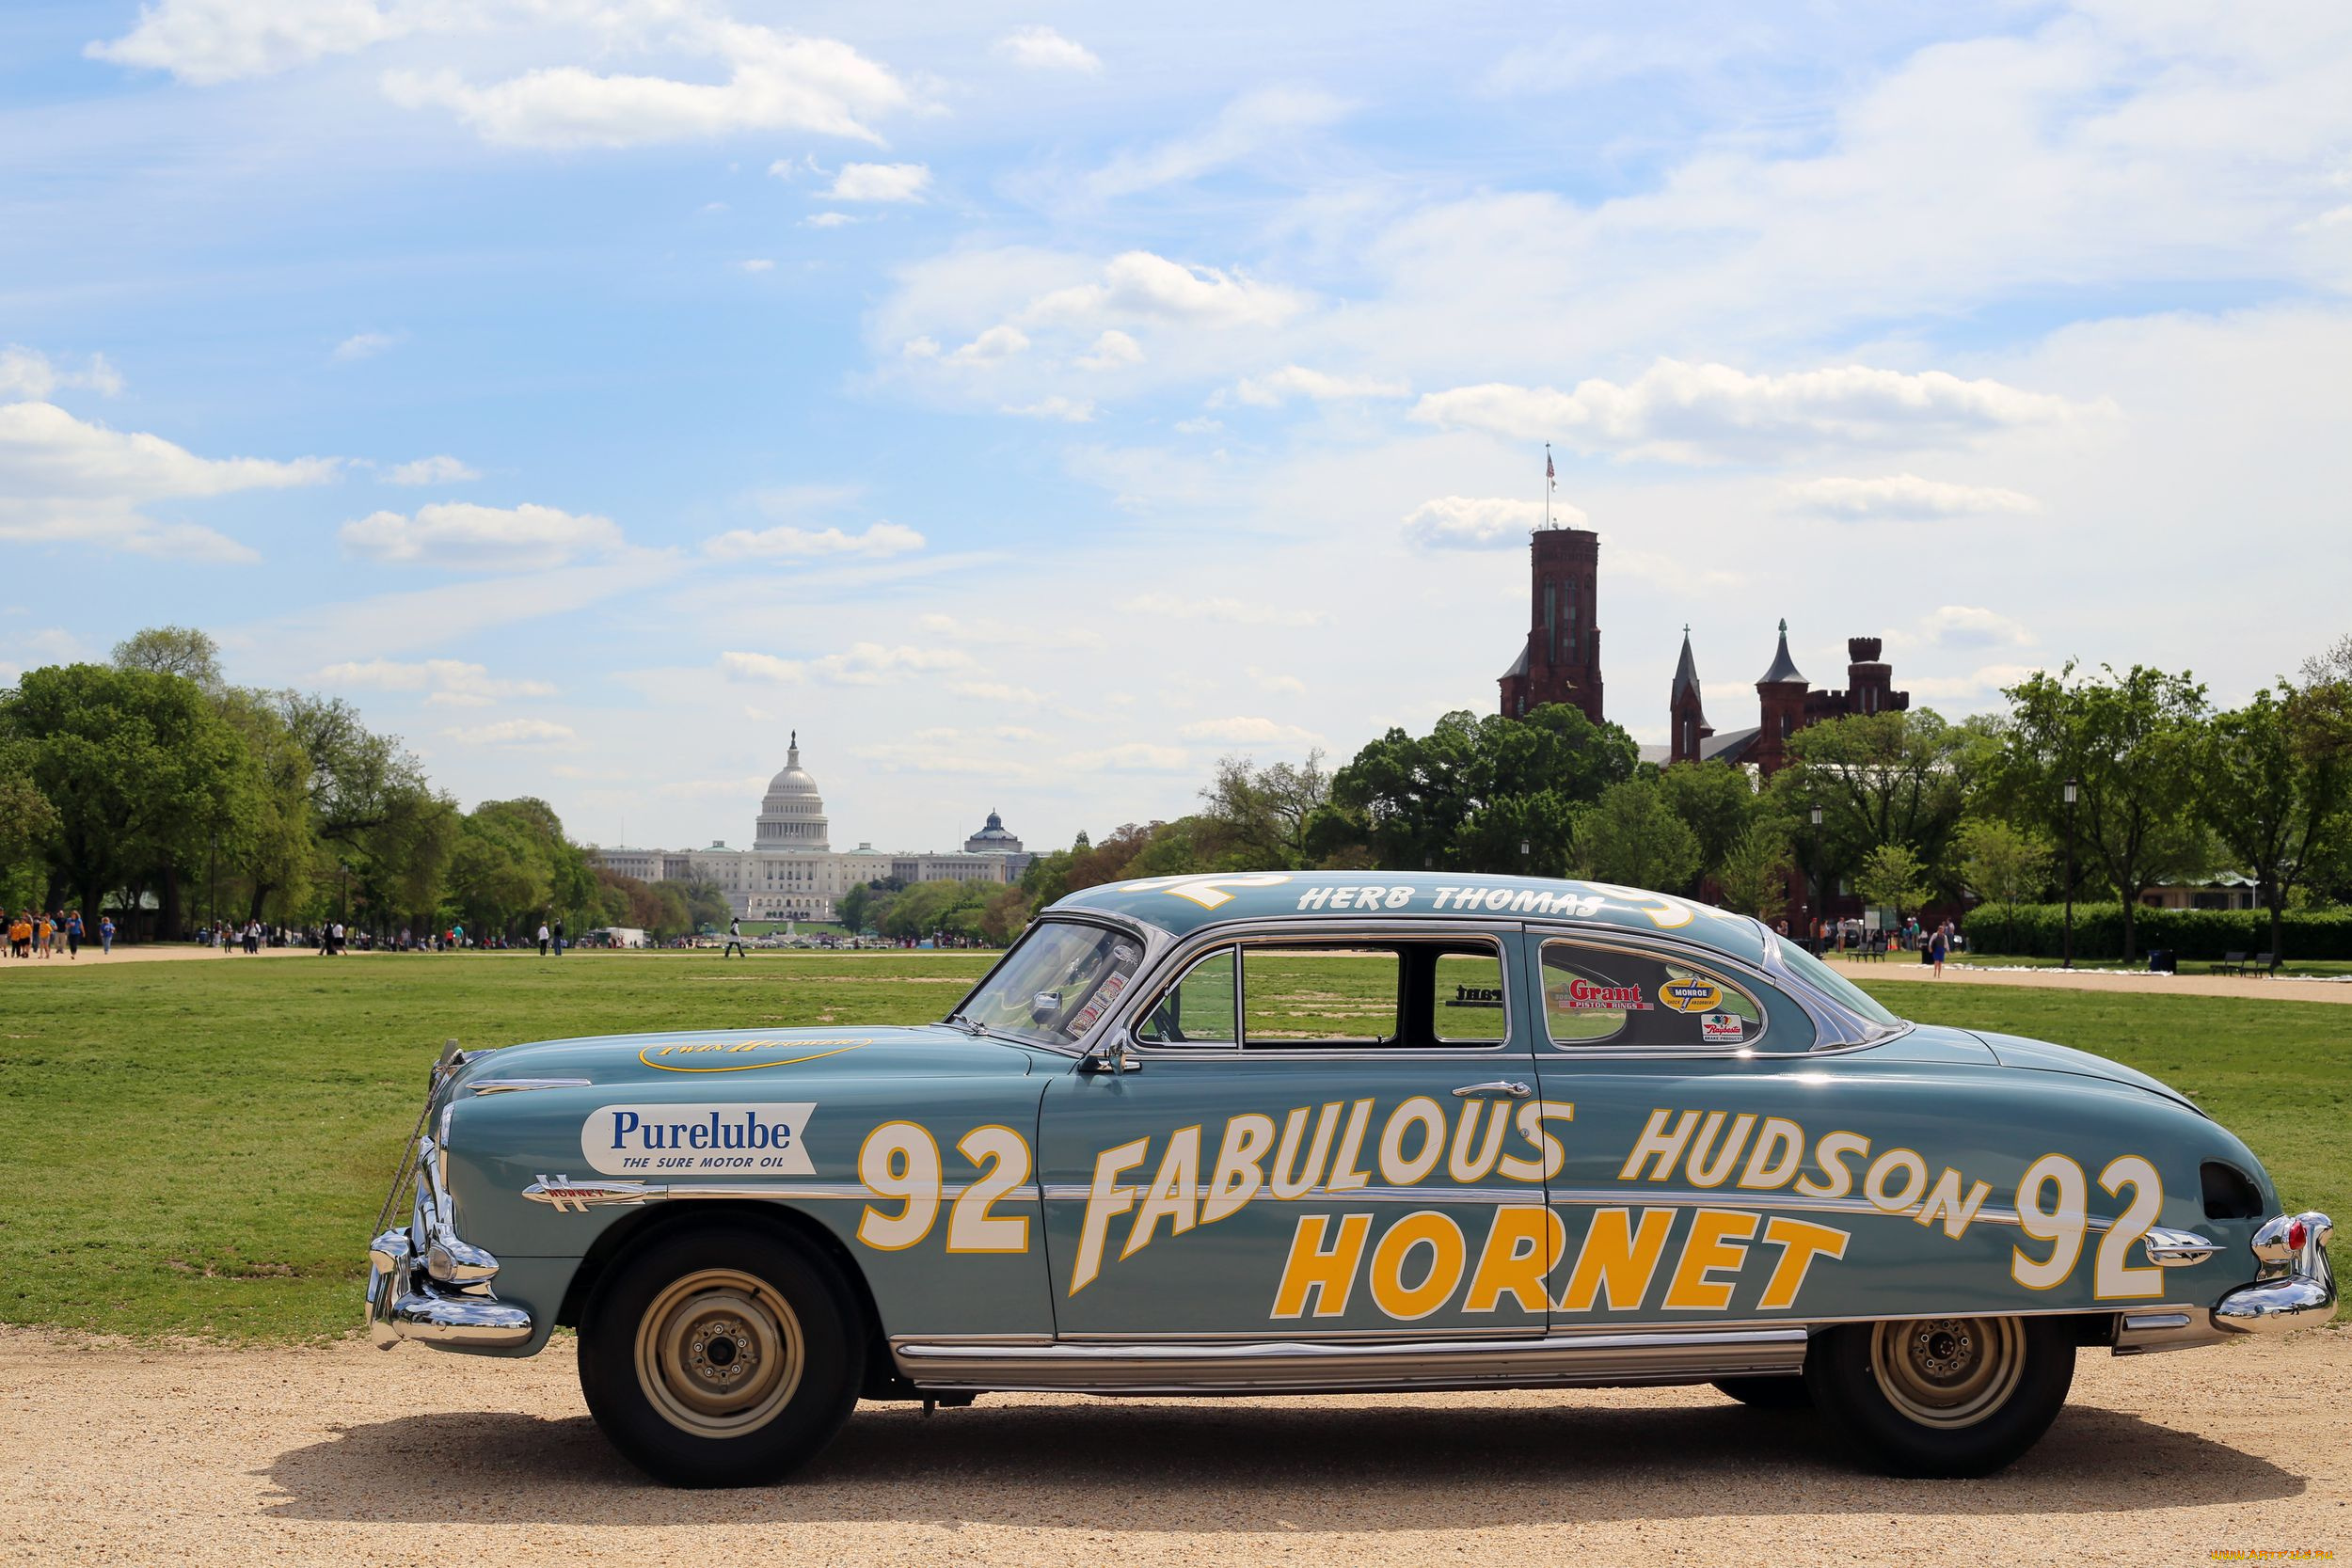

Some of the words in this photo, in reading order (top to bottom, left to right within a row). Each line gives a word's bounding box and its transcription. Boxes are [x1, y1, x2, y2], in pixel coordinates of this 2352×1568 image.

[1296, 886, 1415, 911] HERB
[1433, 887, 1605, 918] THOMAS
[1569, 978, 1643, 1002] Grant
[1675, 989, 1708, 997] MONROE
[657, 1043, 729, 1055] TWIN
[611, 1111, 791, 1149] Purelube
[623, 1157, 650, 1168] THE
[657, 1157, 694, 1168] SURE
[700, 1157, 755, 1168] MOTOR
[760, 1157, 784, 1167] OIL
[1617, 1101, 1994, 1241] HUDSON
[546, 1188, 605, 1198] HORNET
[856, 1120, 1032, 1253] 92
[1069, 1096, 1575, 1298] FABULOUS
[2010, 1153, 2166, 1301] 92
[1270, 1204, 1851, 1322] HORNET
